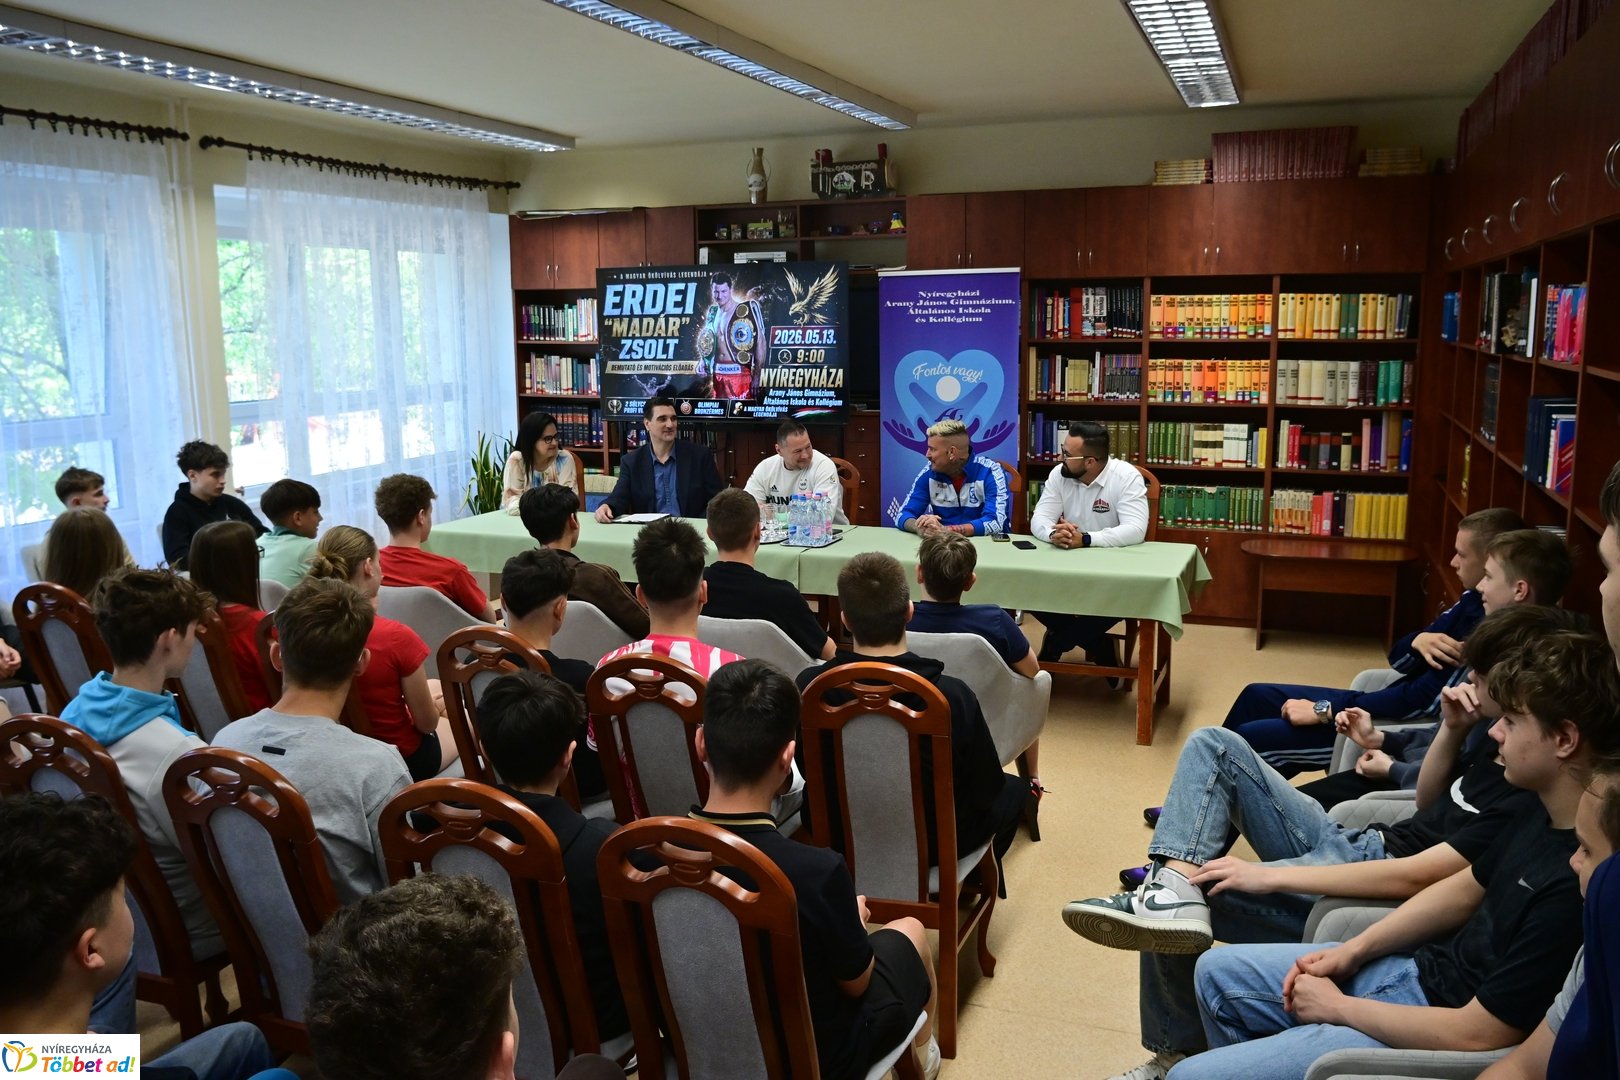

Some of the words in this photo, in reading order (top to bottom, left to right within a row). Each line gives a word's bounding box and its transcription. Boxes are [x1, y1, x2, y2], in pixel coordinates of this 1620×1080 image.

[625, 272, 646, 280] MAGYAR
[678, 270, 708, 278] LEGENDÁJA
[603, 282, 697, 315] ERDEI
[918, 290, 980, 299] Nyíregyházi
[884, 300, 915, 308] Arany
[916, 299, 948, 307] János
[907, 307, 956, 315] Általános
[958, 306, 992, 314] Iskola
[928, 315, 983, 323] Kollégium
[774, 330, 836, 344] 2026.05.13.
[619, 339, 678, 359] ZSOLT
[797, 349, 825, 363] 9:00
[636, 363, 643, 371] ÉS
[672, 363, 694, 371] ELŐADÁS
[759, 366, 843, 387] NYÍREGYHÁZA
[912, 362, 951, 380] Fontos
[953, 369, 984, 383] vagy!
[768, 388, 786, 398] Arany
[786, 388, 803, 397] János
[803, 388, 836, 398] Gimnázium,
[763, 397, 789, 406] Általános
[789, 397, 807, 406] Iskola
[807, 398, 815, 406] és
[815, 398, 843, 407] Kollégium
[694, 407, 724, 415] BRONZÉRMES
